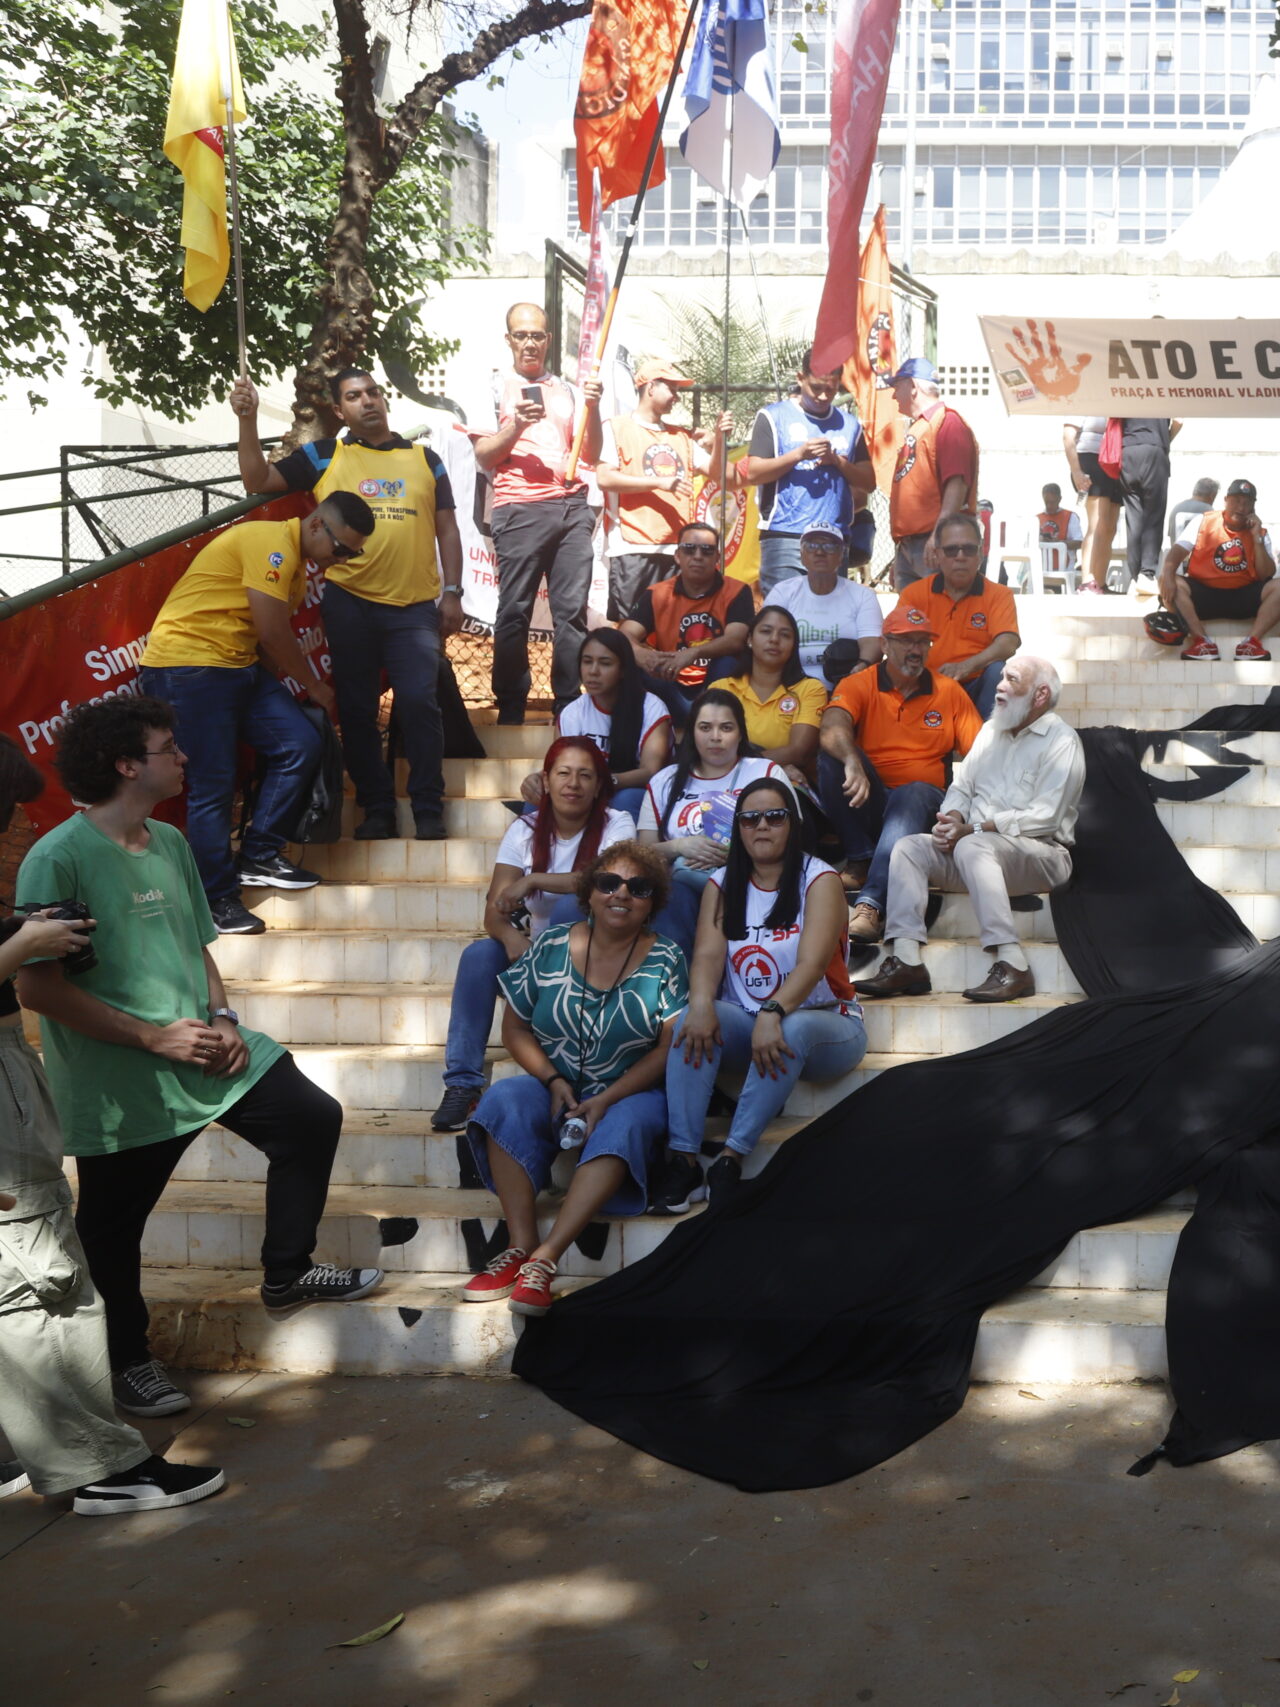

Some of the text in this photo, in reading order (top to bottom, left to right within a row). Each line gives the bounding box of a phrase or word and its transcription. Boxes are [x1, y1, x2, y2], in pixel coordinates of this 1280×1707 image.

[1108, 340, 1198, 380] ATO
[1209, 340, 1243, 379] E
[1111, 387, 1155, 400] PRAÇA
[1158, 388, 1166, 397] E
[1169, 387, 1235, 398] MEMORIAL
[84, 631, 151, 682] Sinpr
[745, 976, 771, 987] UGT
